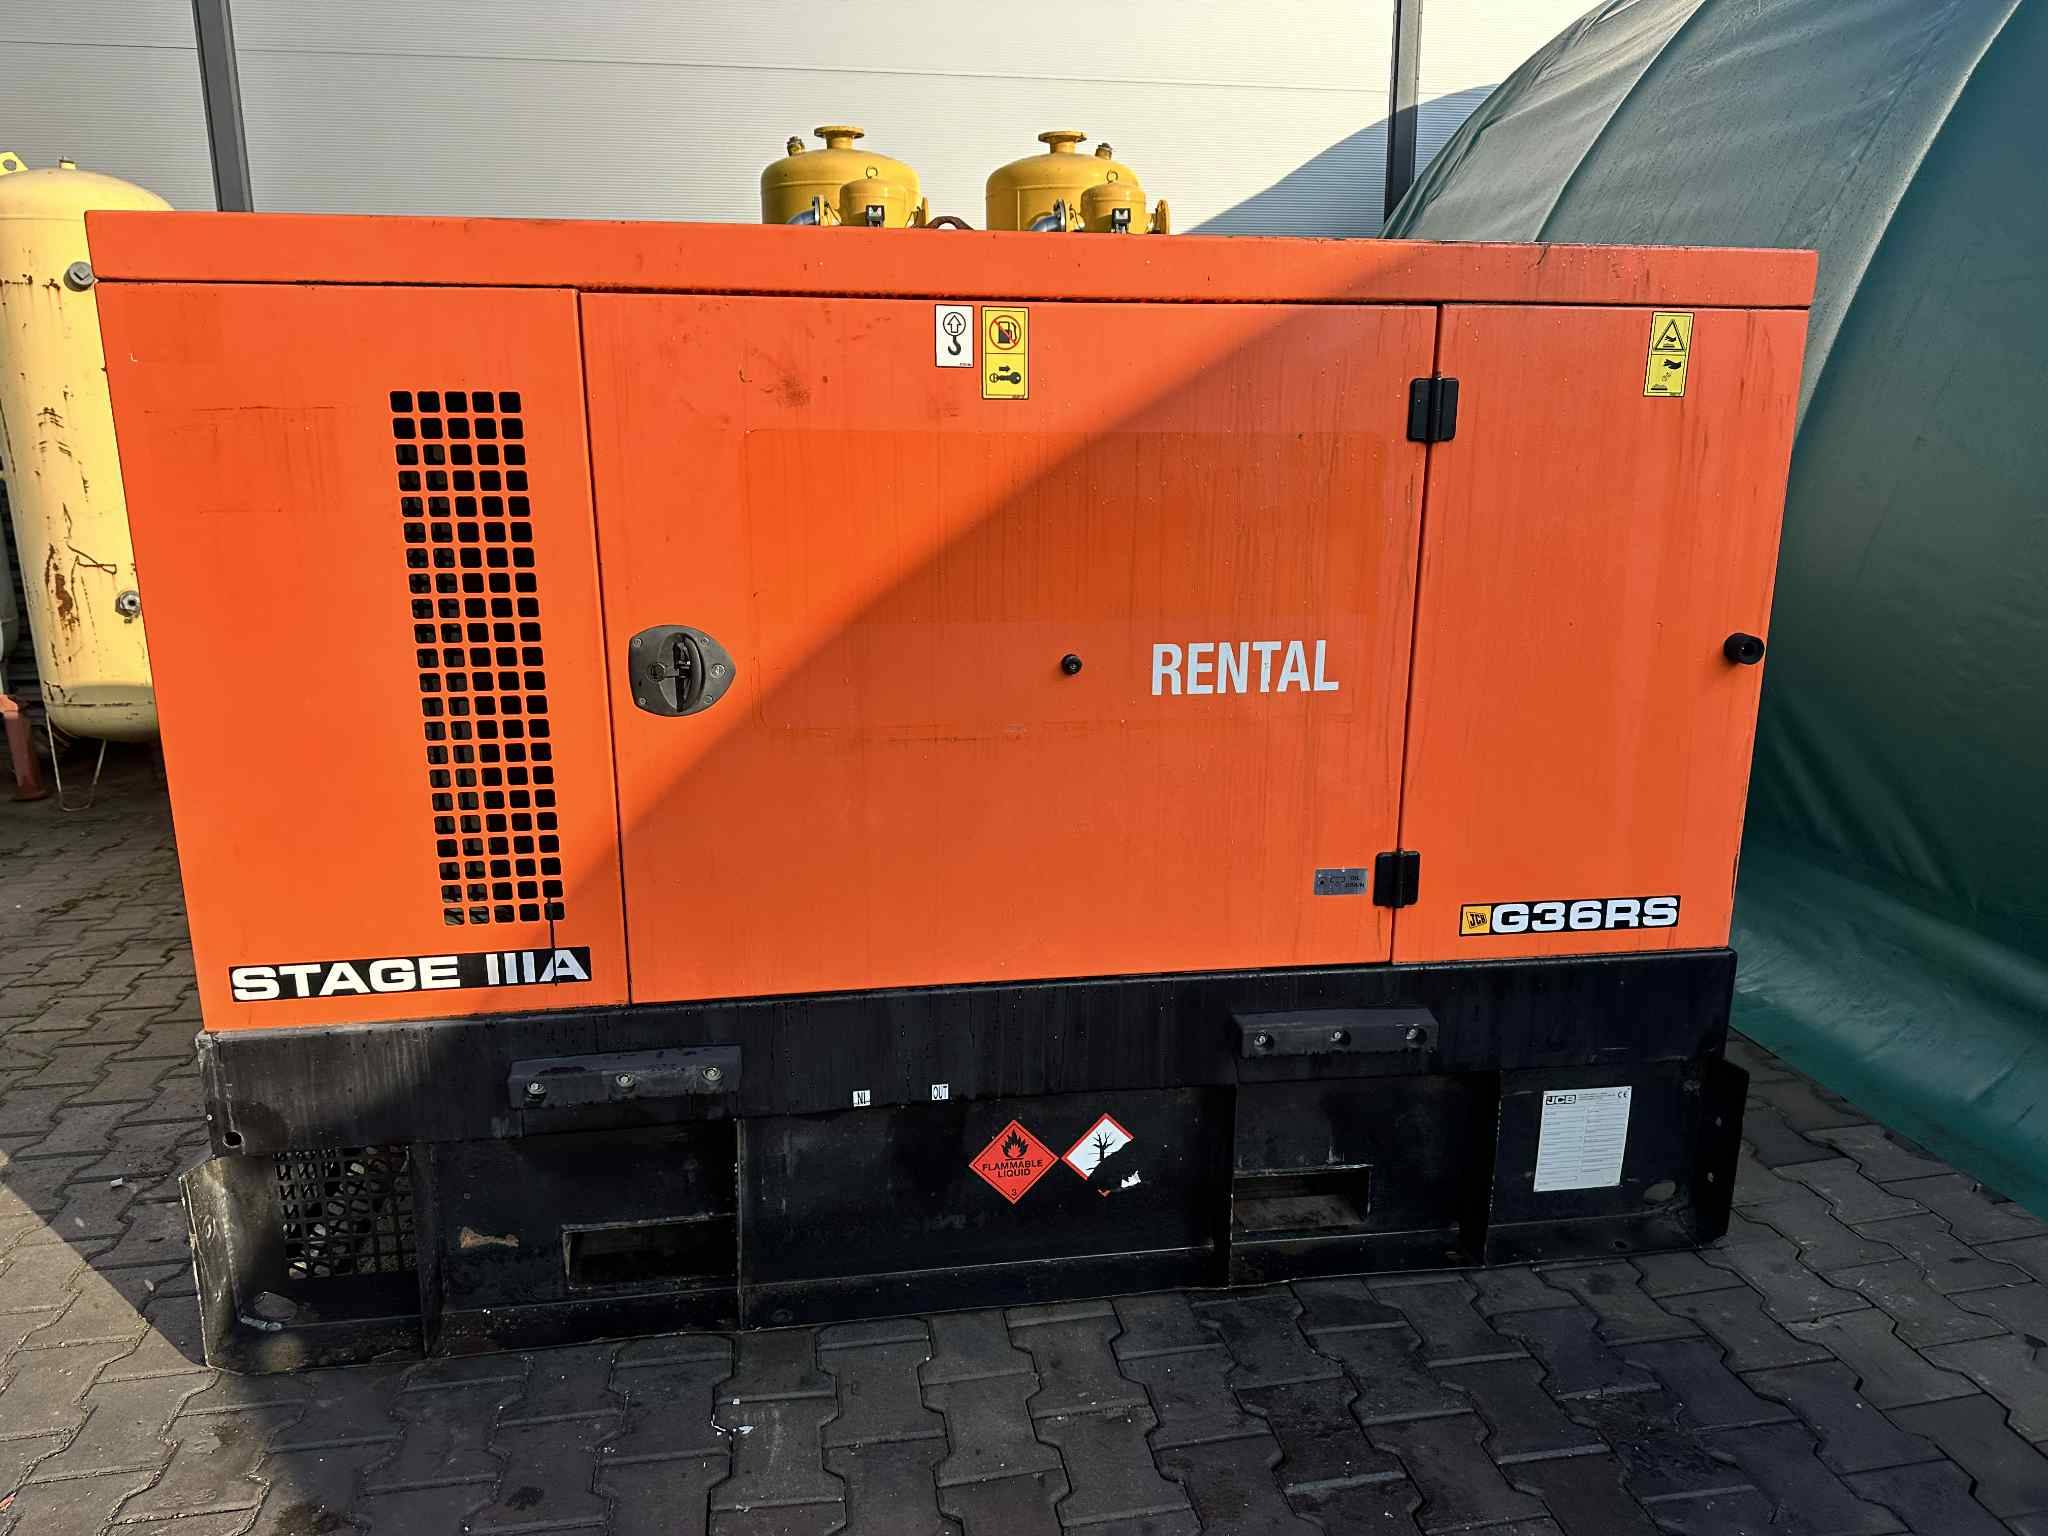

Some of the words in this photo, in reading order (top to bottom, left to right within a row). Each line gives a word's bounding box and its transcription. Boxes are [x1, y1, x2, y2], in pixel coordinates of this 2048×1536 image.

[1151, 639, 1340, 696] RENTAL
[1466, 911, 1488, 929] JCB
[1491, 896, 1679, 933] G36RS
[231, 955, 461, 1000] STAGE
[485, 950, 590, 986] IIIA
[932, 1086, 948, 1099] OUT
[1545, 1095, 1577, 1106] JCB
[983, 1160, 1043, 1172] FLAMMABLE
[997, 1168, 1032, 1178] LIQUID
[1011, 1189, 1017, 1197] 3
